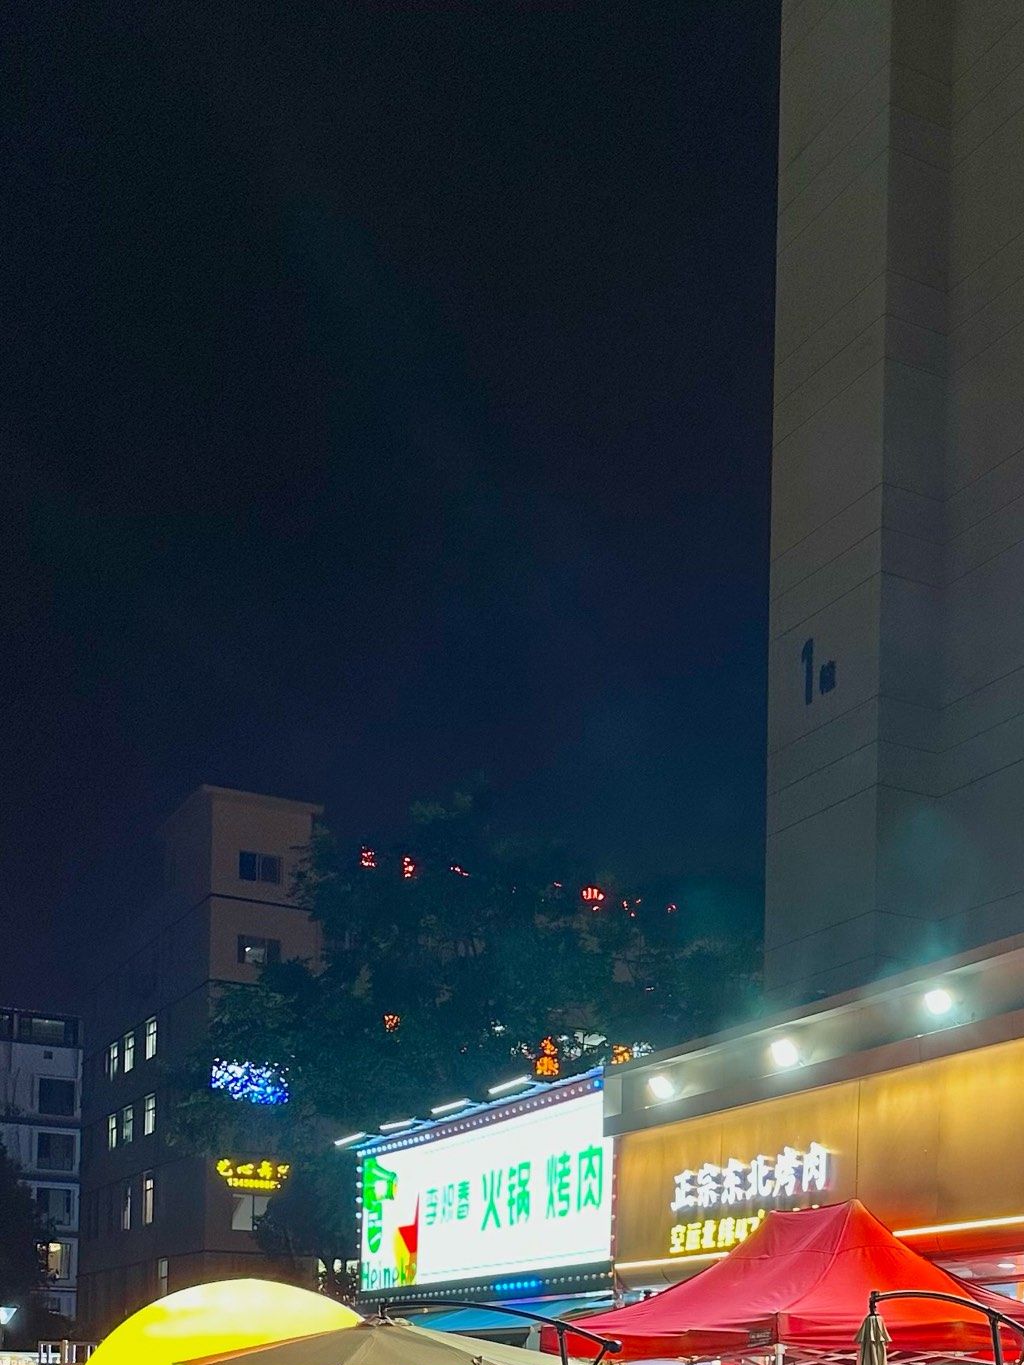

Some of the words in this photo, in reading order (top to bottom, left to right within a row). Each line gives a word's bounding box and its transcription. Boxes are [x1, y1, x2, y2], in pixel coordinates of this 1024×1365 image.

[480, 1161, 532, 1231] 火锅
[545, 1144, 604, 1220] 烤肉
[670, 1141, 828, 1211] 正宗东北烤肉
